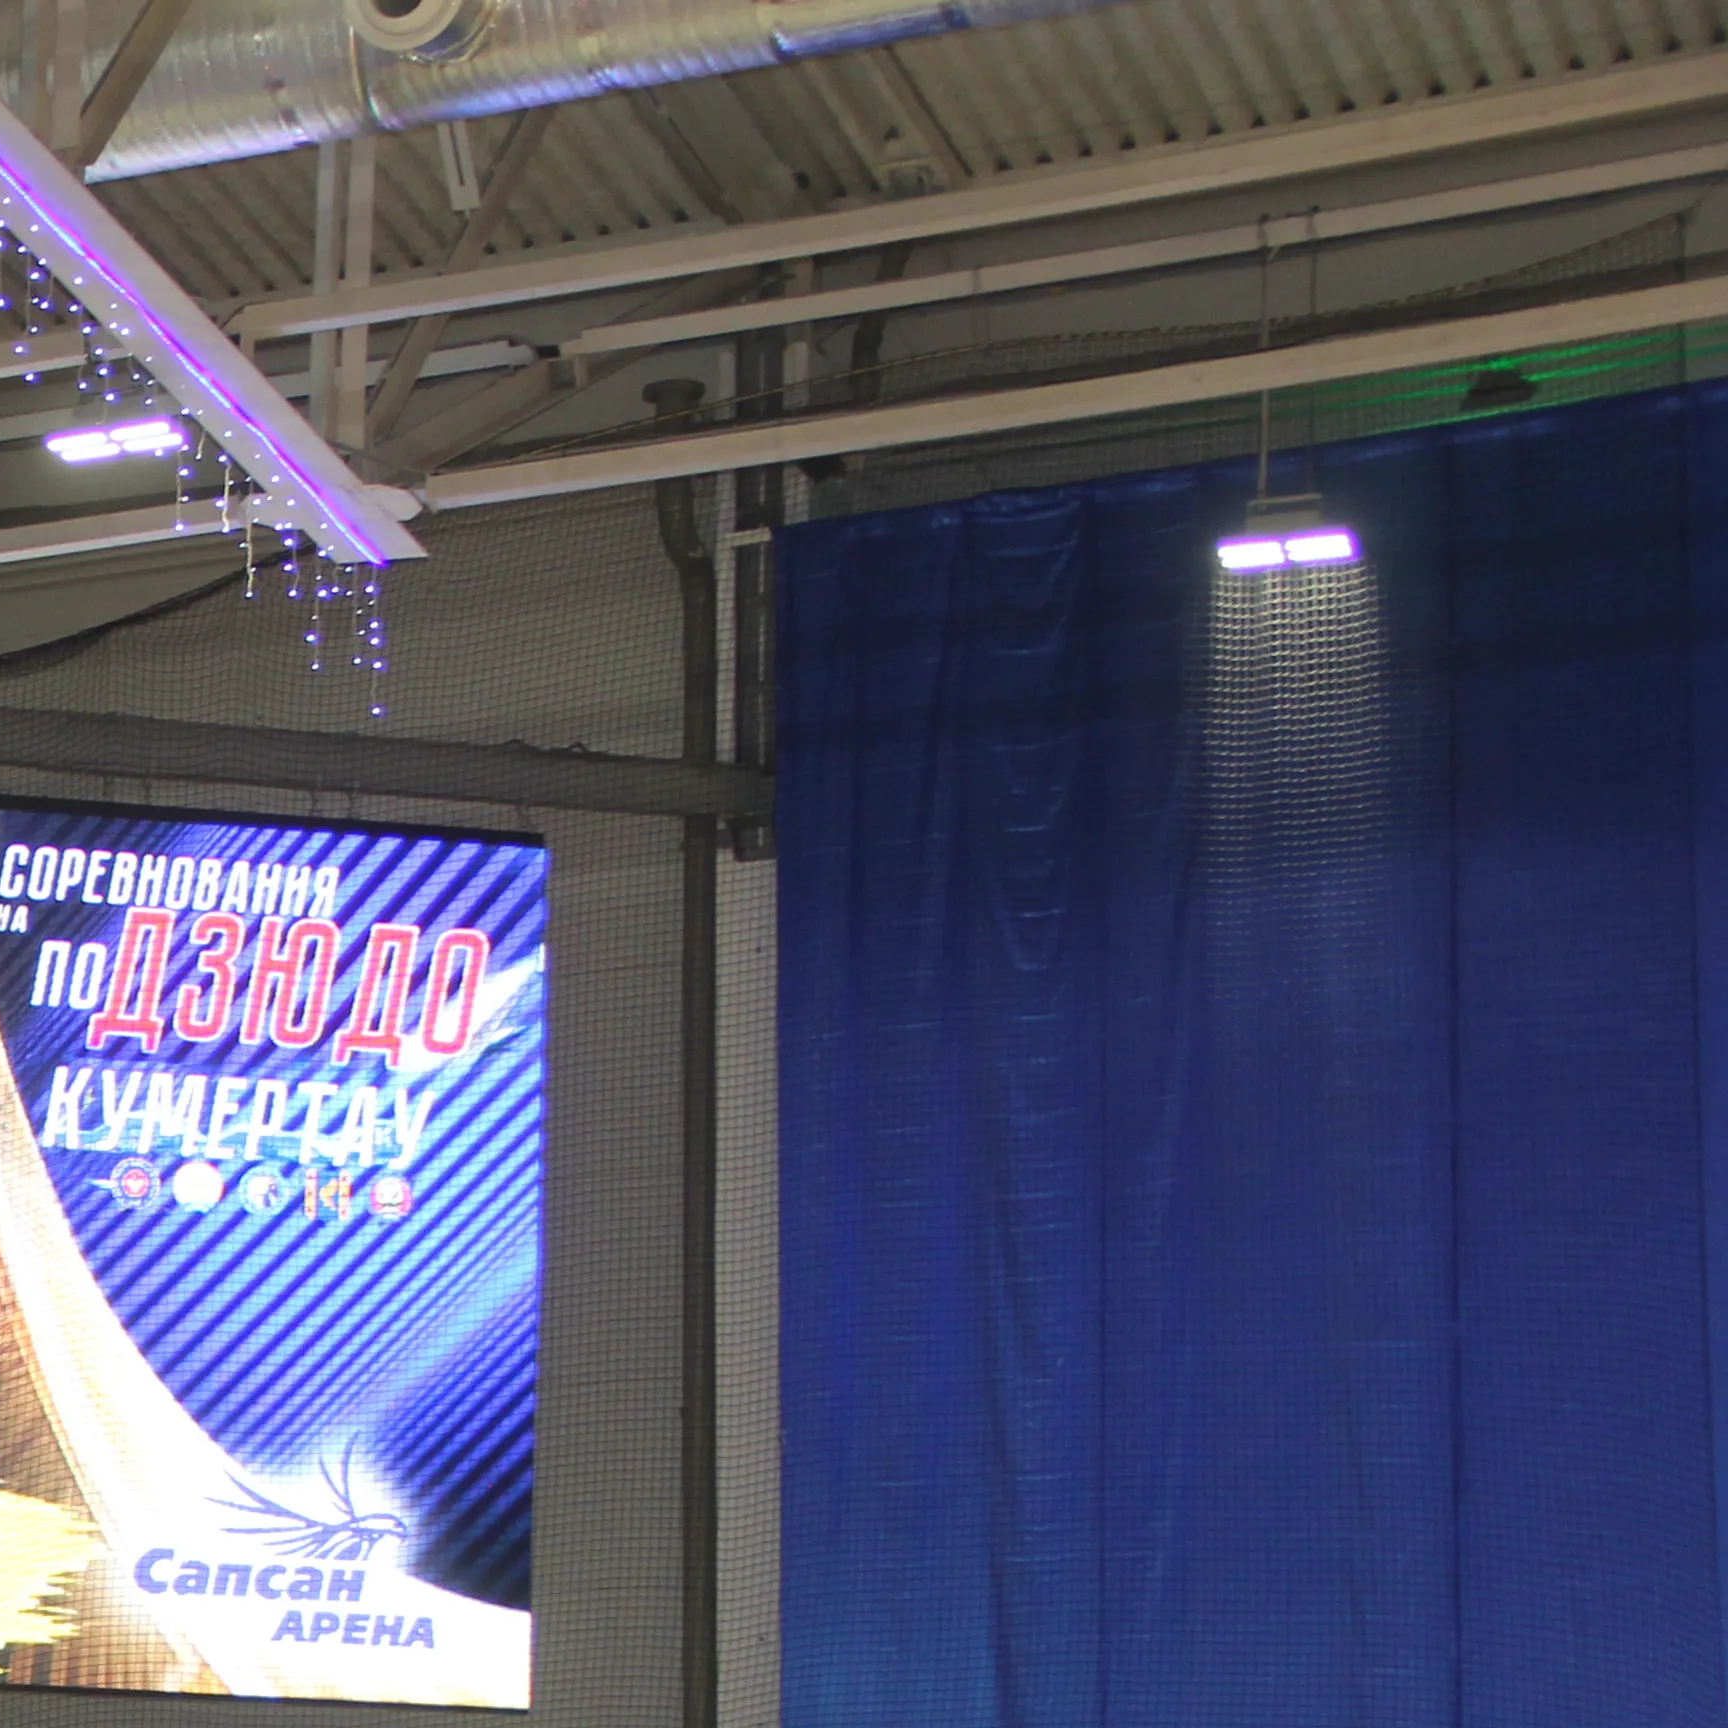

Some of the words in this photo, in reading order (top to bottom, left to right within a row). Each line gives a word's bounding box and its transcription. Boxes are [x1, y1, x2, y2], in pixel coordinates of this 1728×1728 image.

[0, 843, 341, 919] СОРЕВНОВАНИЯ
[42, 1065, 436, 1170] КУМЕРТАУ
[132, 1547, 366, 1602] Сапсан
[270, 1609, 435, 1650] АРЕНА
